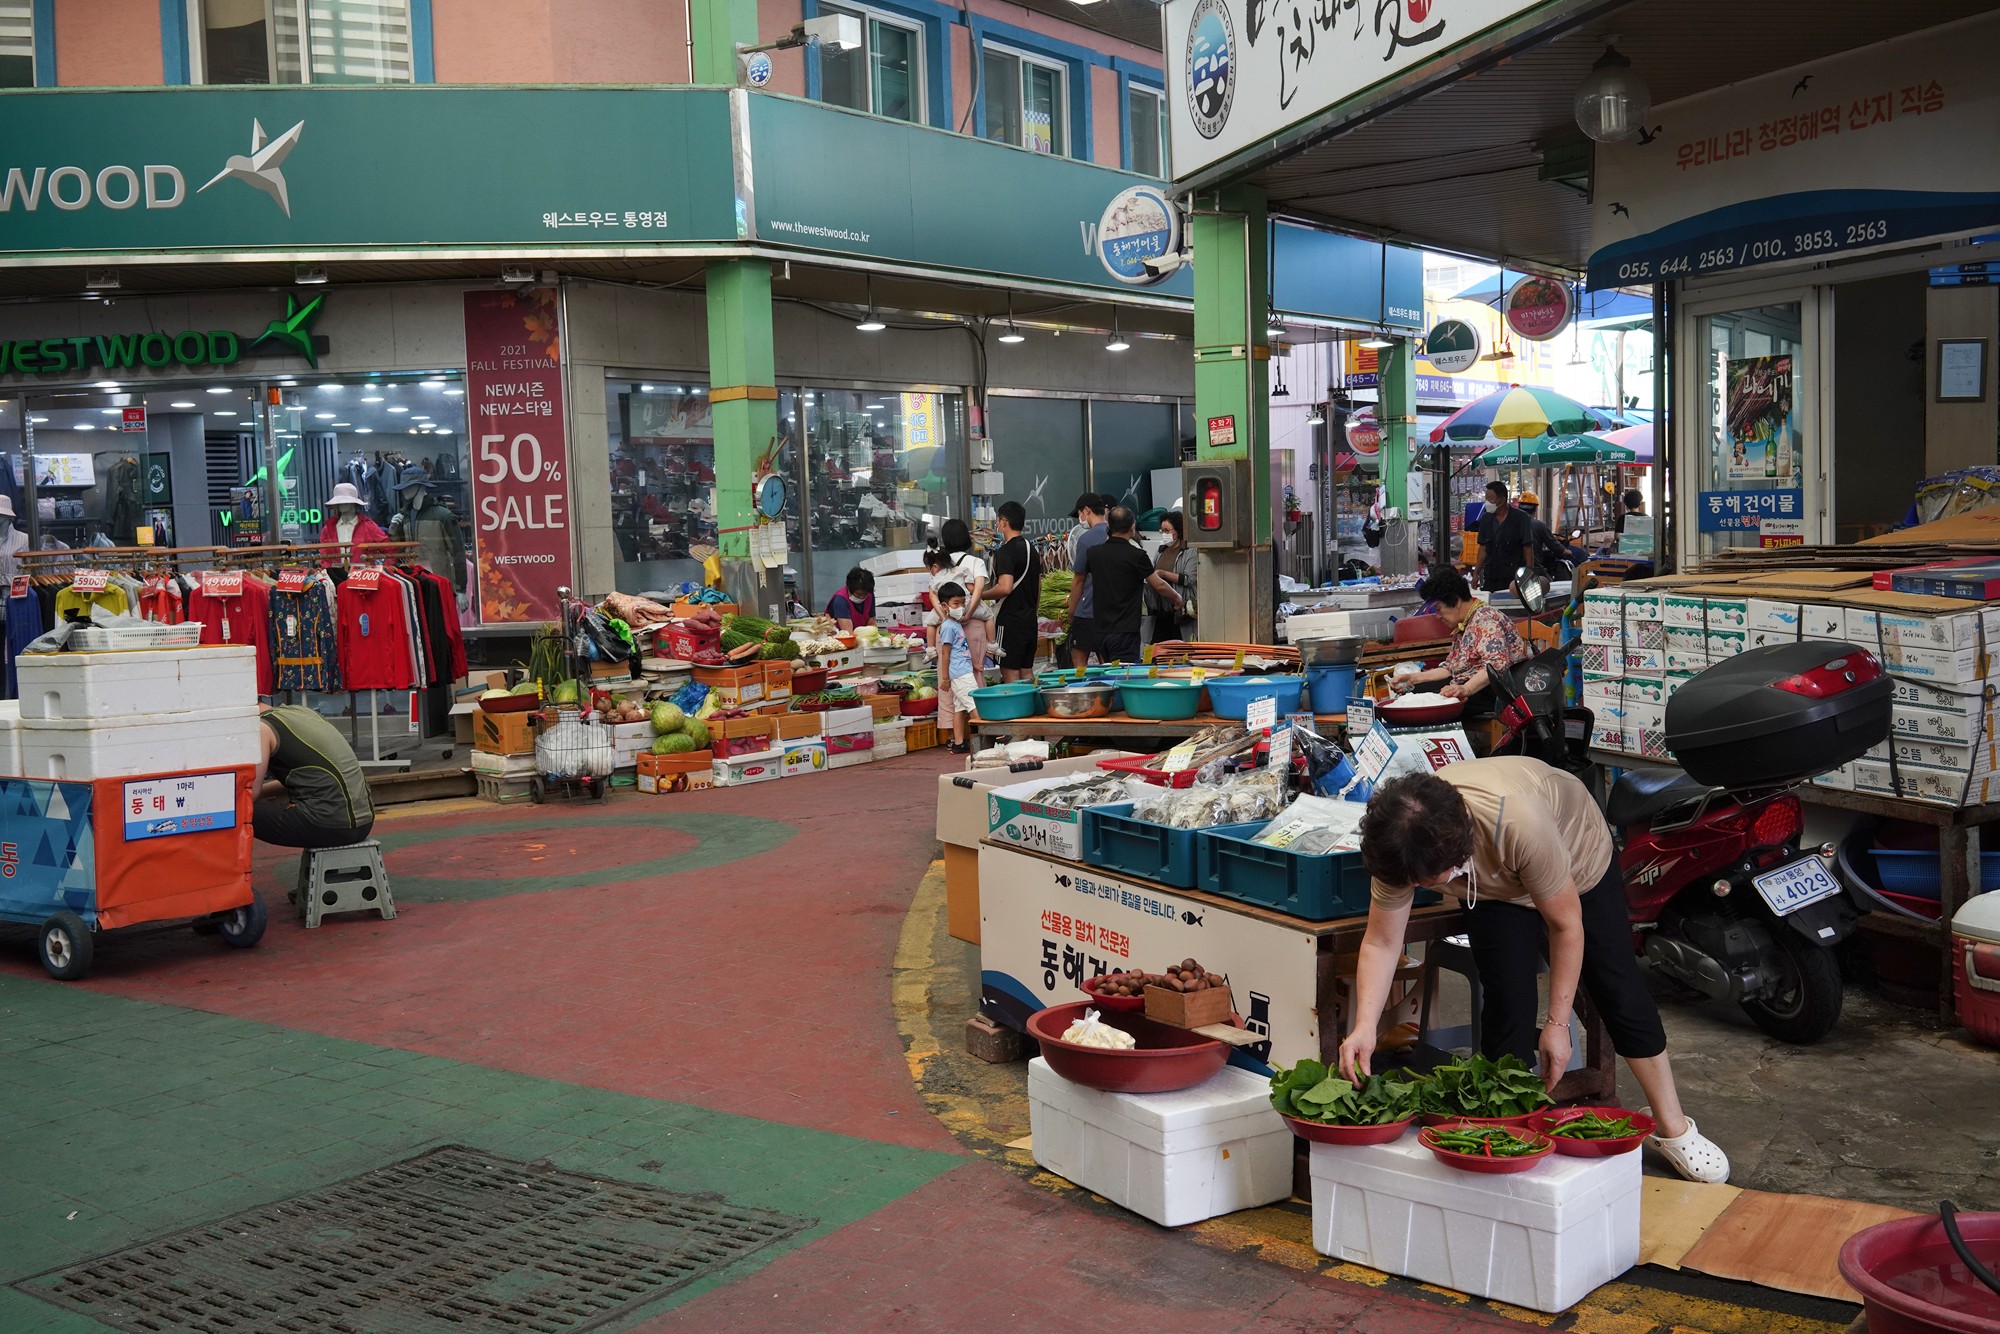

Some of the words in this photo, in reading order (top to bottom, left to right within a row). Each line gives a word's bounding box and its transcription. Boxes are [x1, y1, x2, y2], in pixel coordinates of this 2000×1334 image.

[1676, 127, 1752, 171] 우리나라
[1758, 105, 1841, 152] 청정해역
[1847, 91, 1893, 131] 산지
[1900, 79, 1945, 116] 직송
[541, 212, 619, 229] 웨스트우드
[623, 211, 668, 229] 통영점
[771, 219, 870, 243] www.thewestwood.co.kr
[1618, 262, 1653, 280] 055.
[1659, 255, 1692, 275] 644.
[1699, 247, 1734, 268] 2563
[1752, 239, 1786, 259] 010.
[1794, 230, 1839, 254] 3853.
[1847, 220, 1888, 245] 2563
[0, 330, 240, 374] ESTWOOD
[500, 345, 527, 356] 2021
[471, 361, 497, 371] FALL
[503, 358, 556, 370] FESTIVAL
[1435, 355, 1467, 366] 웨스트우드
[485, 382, 545, 397] NEW시즌
[480, 400, 553, 416] NEW스타일
[1210, 418, 1232, 428] 소화기
[478, 432, 562, 484] 50%
[480, 494, 565, 531] SALE
[1708, 494, 1795, 514] 동해건어물
[494, 554, 555, 566] WESTWOOD
[77, 577, 106, 587] 59,000
[205, 577, 241, 587] 49,000
[278, 573, 305, 584] 39,000
[349, 570, 380, 581] 29,000
[176, 781, 195, 792] 1마리
[1022, 824, 1047, 847] 오징어
[1786, 872, 1829, 900] 4029
[1074, 877, 1096, 896] 믿음과
[1097, 883, 1120, 903] 신뢰가
[1121, 890, 1142, 911] 품질을
[1143, 897, 1177, 922] 만듭니다.
[1041, 909, 1072, 937] 선물용
[1075, 919, 1096, 946] 멸치
[1099, 926, 1130, 958] 전문점
